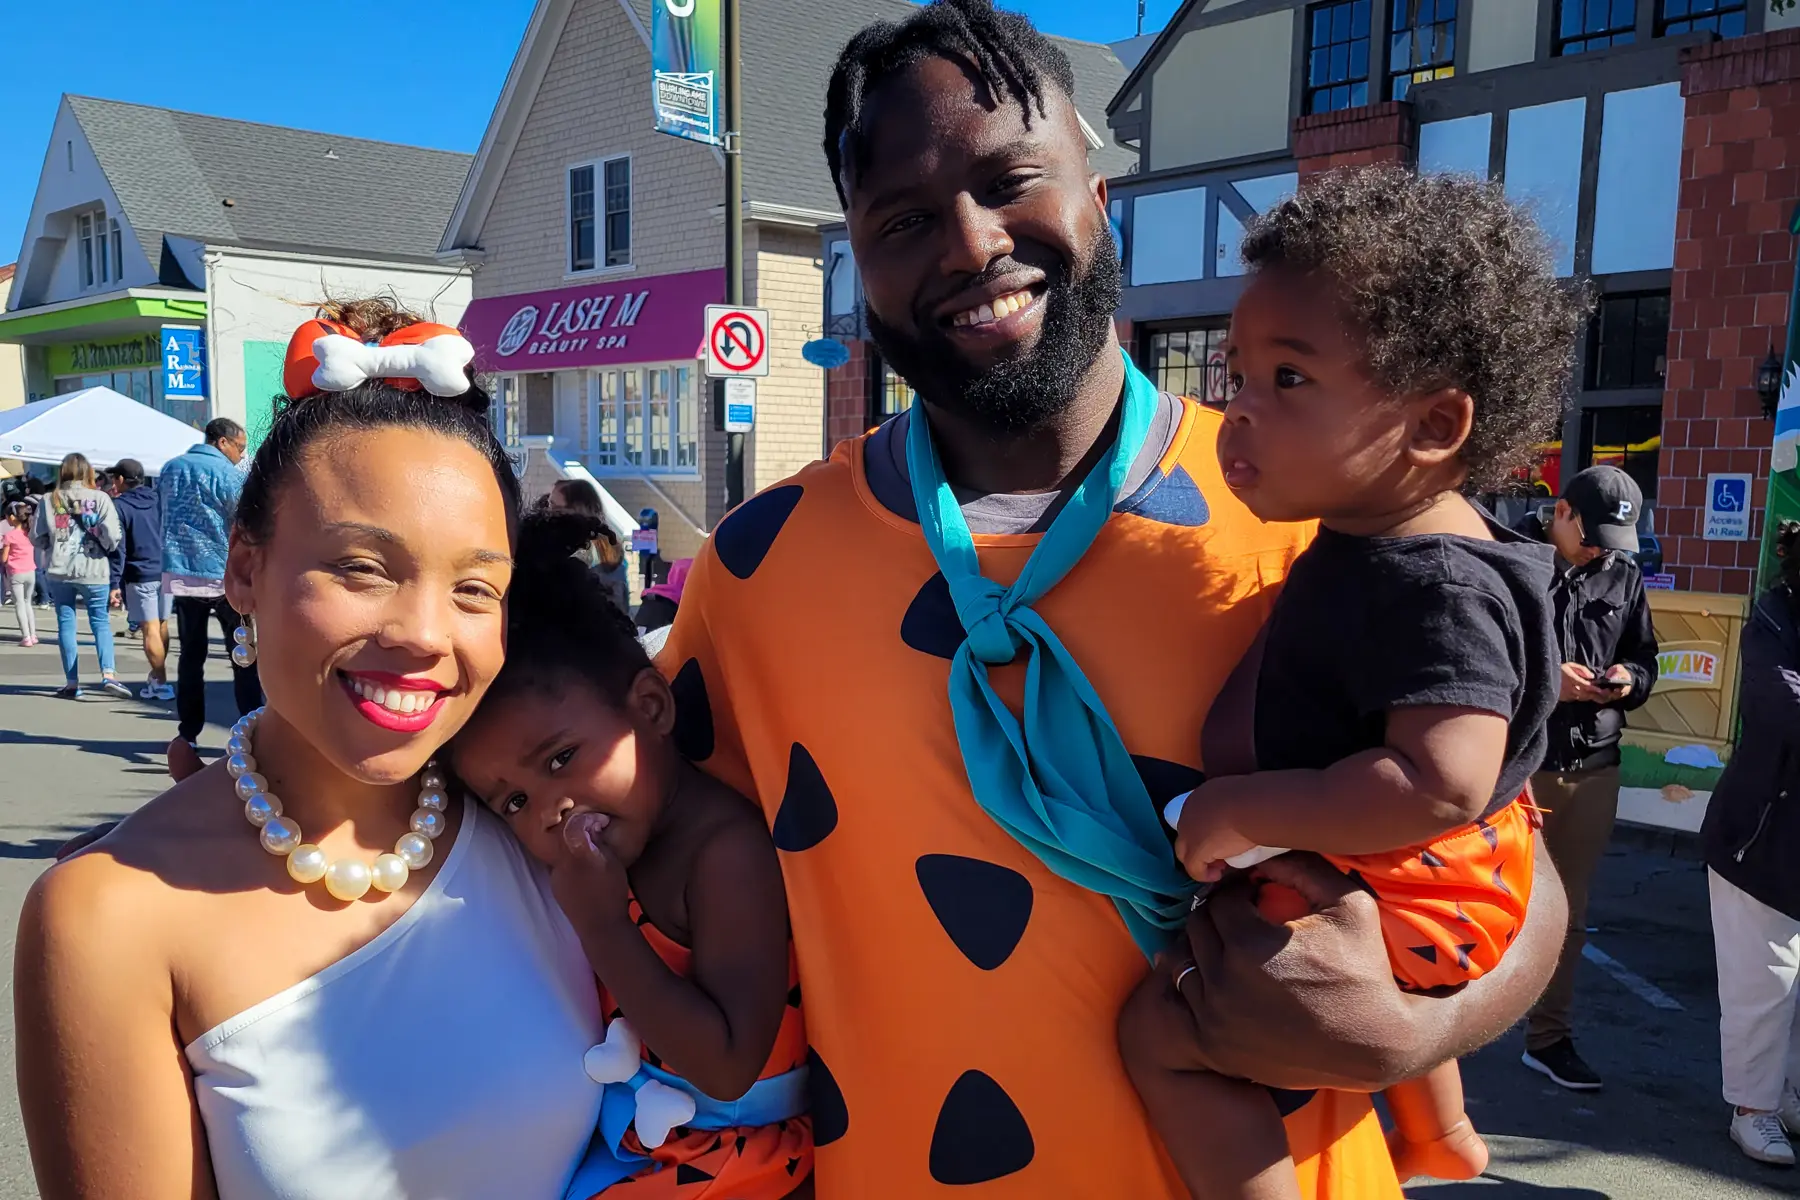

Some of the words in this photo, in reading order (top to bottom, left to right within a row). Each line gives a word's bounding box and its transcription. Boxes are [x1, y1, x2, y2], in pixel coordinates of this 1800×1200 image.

[659, 91, 706, 109] DOWNTOWN
[539, 295, 615, 339] LASH
[610, 291, 649, 327] M
[166, 335, 180, 351] A
[528, 338, 589, 354] BEAUTY
[596, 335, 627, 349] SPA
[1616, 500, 1632, 520] P
[1709, 515, 1743, 525] Access
[1721, 527, 1743, 537] Rear
[1659, 653, 1713, 676] WAVE
